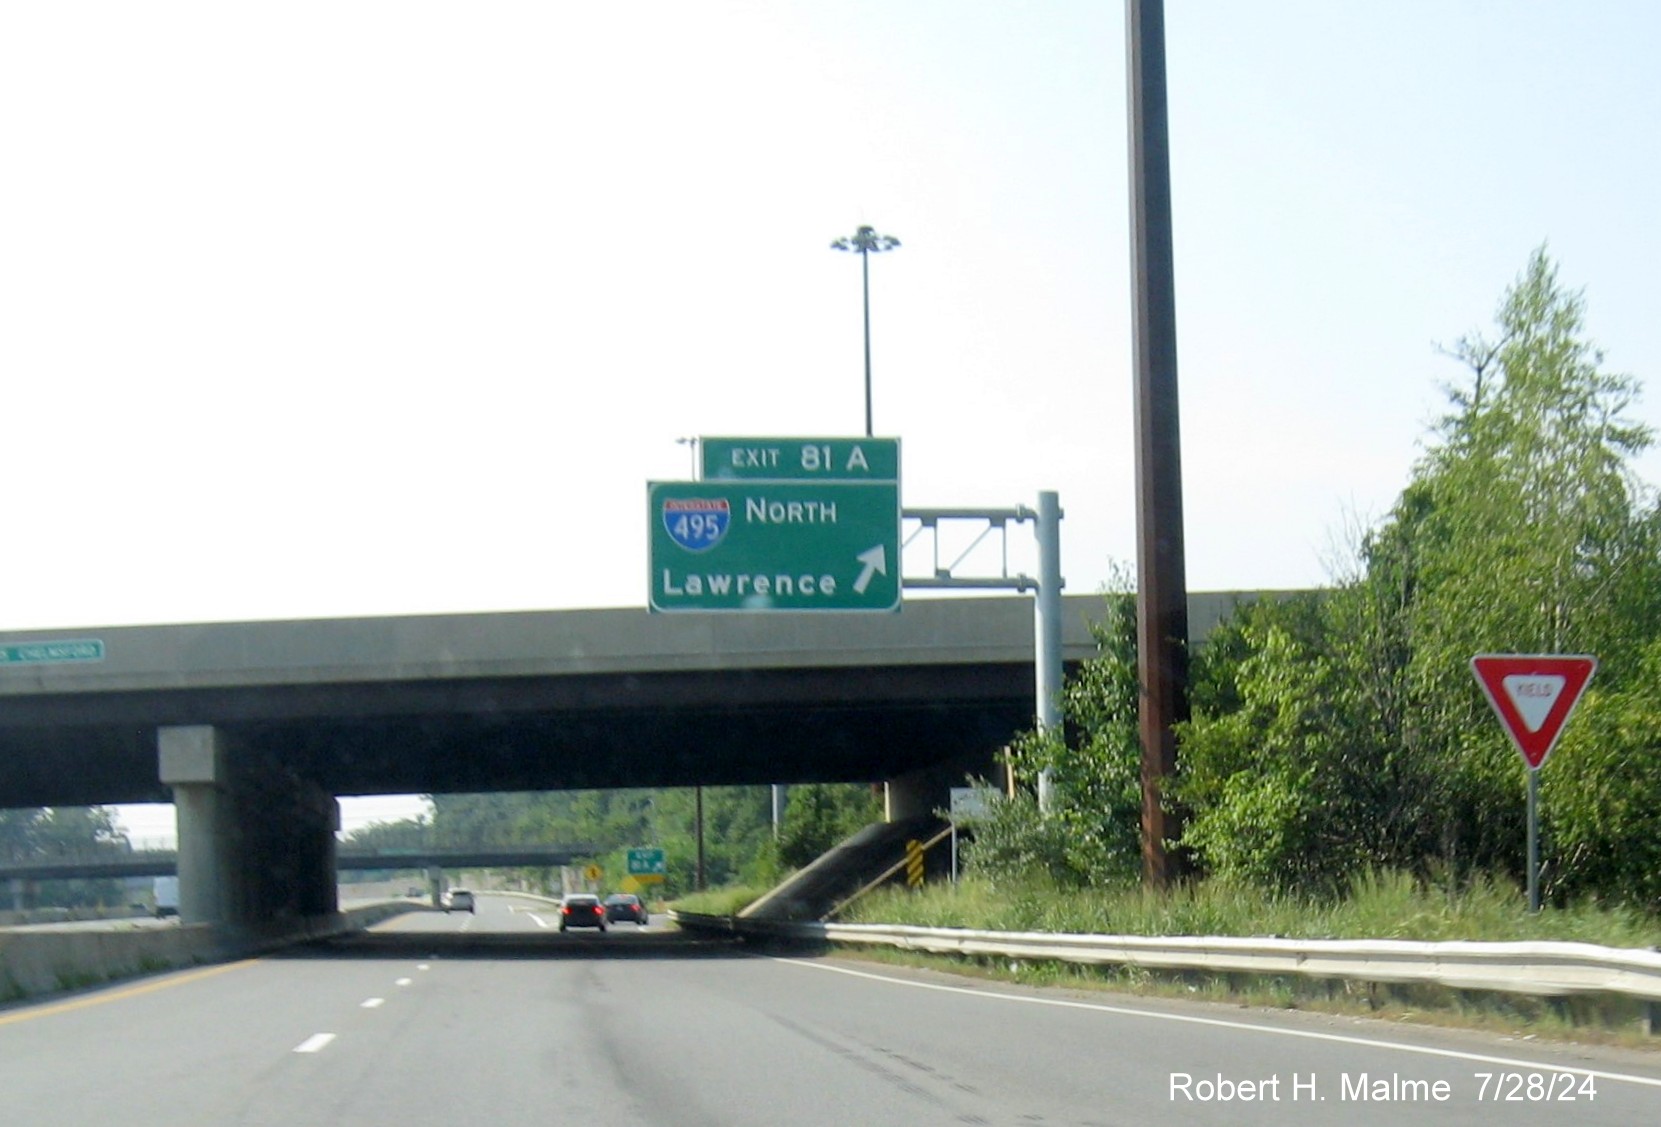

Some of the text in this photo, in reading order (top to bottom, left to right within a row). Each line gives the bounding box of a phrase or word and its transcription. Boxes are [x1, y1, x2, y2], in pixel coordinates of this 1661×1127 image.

[731, 444, 869, 471] EXIT 81 A
[745, 497, 837, 524] NORTH
[674, 514, 719, 541] 495
[662, 568, 837, 596] Lawrence
[1516, 682, 1554, 698] YIELD
